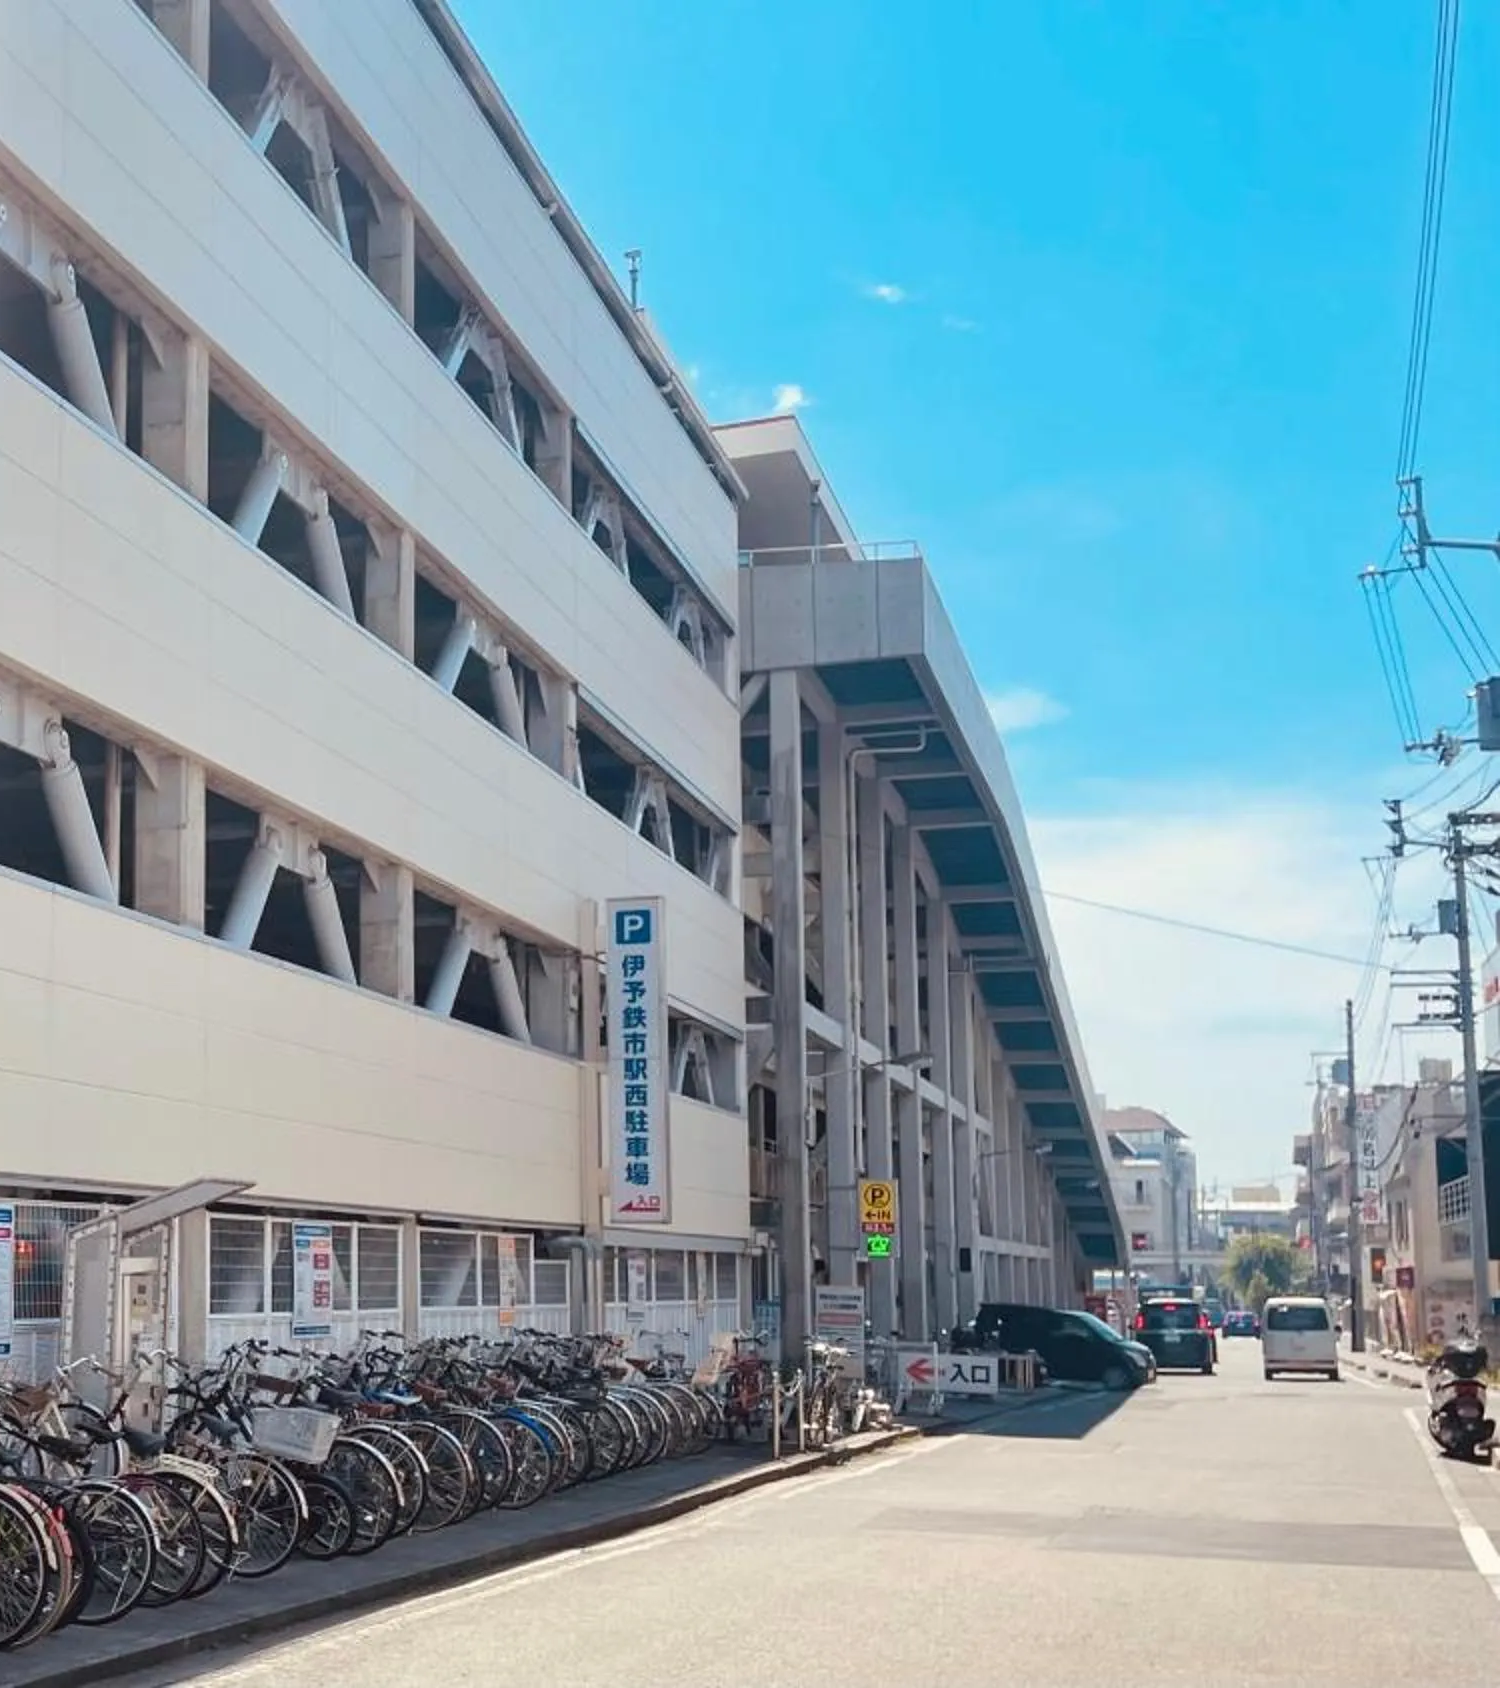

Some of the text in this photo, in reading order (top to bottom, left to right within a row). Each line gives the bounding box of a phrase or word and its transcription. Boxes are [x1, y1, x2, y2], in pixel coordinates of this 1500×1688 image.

[623, 914, 644, 941] P
[621, 955, 650, 1187] 伊予鉄市駅西駐車場
[636, 1194, 660, 1207] 入口
[877, 1210, 891, 1221] IN
[950, 1362, 990, 1384] 入口
